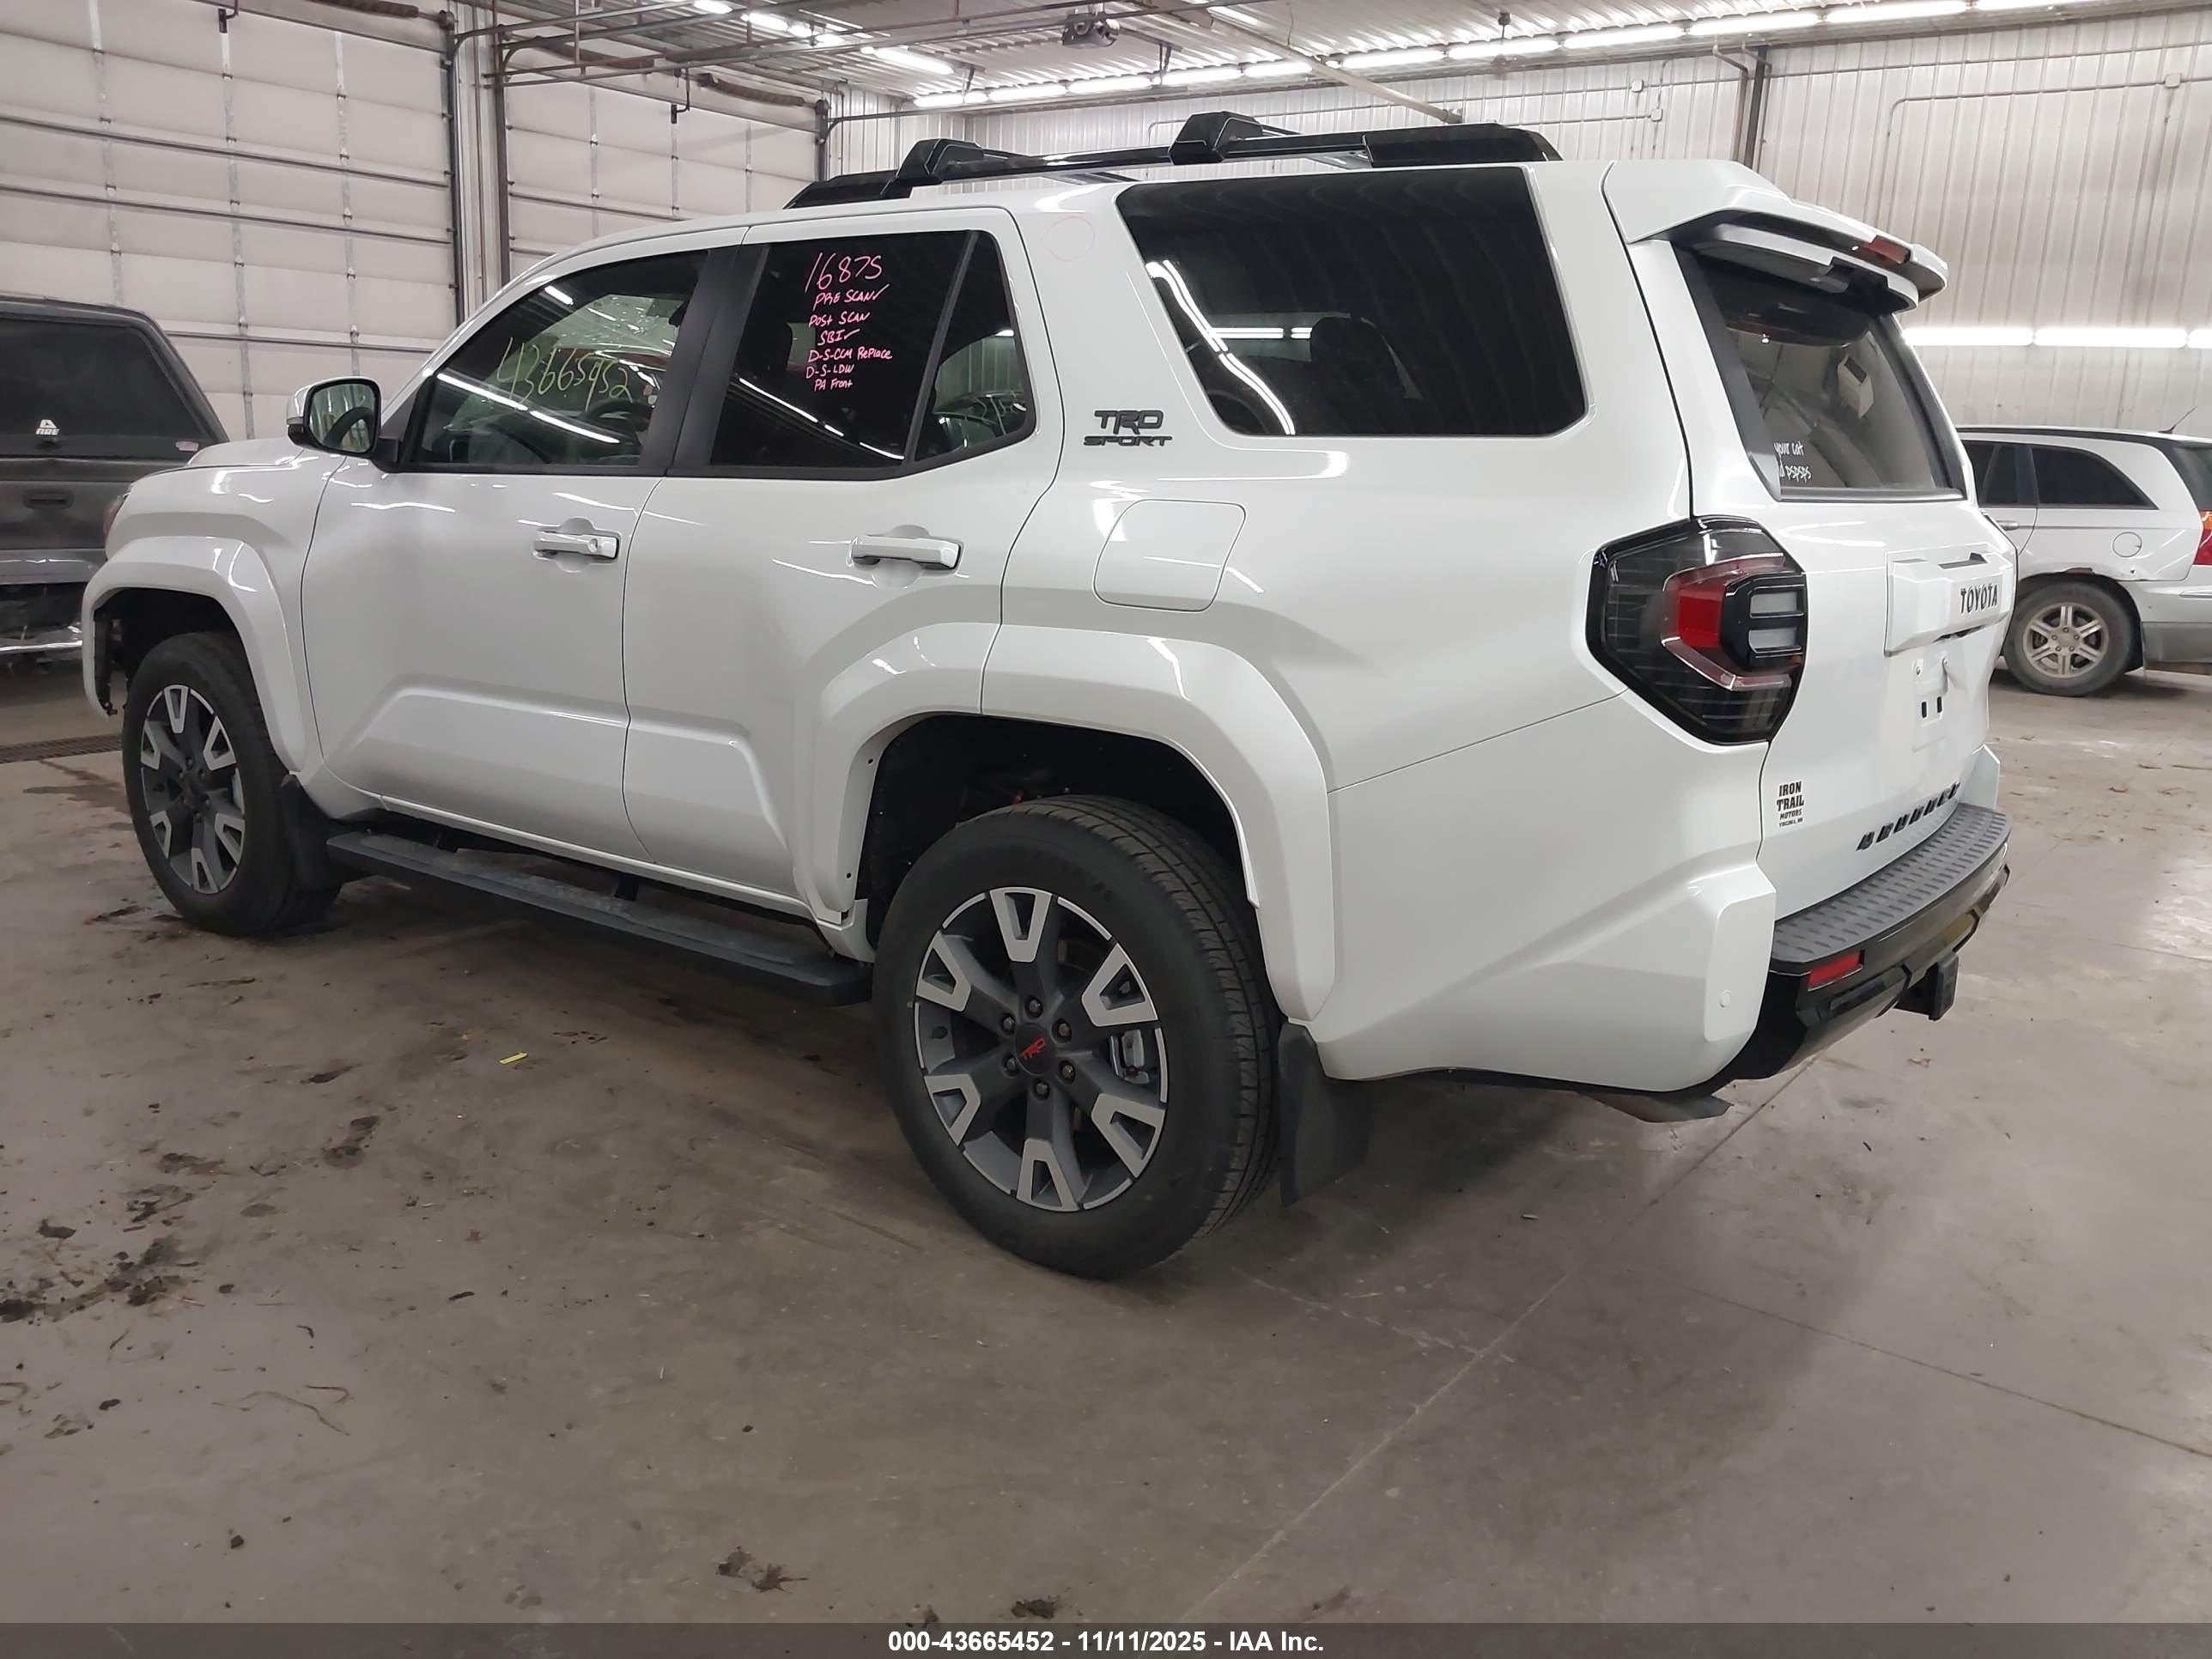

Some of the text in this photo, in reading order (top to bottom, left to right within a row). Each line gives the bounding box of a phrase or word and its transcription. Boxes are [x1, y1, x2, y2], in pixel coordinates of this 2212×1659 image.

[805, 252, 883, 293] 16875
[813, 289, 876, 311] PRE SCAN
[839, 311, 871, 325] SCAN
[1094, 410, 1164, 434] TRD
[1083, 435, 1173, 447] SPORT
[1960, 584, 1998, 614] TOYOTA
[1778, 781, 1802, 797] IRON
[1776, 794, 1805, 811] TRAIL
[1779, 808, 1802, 821] MOTORS
